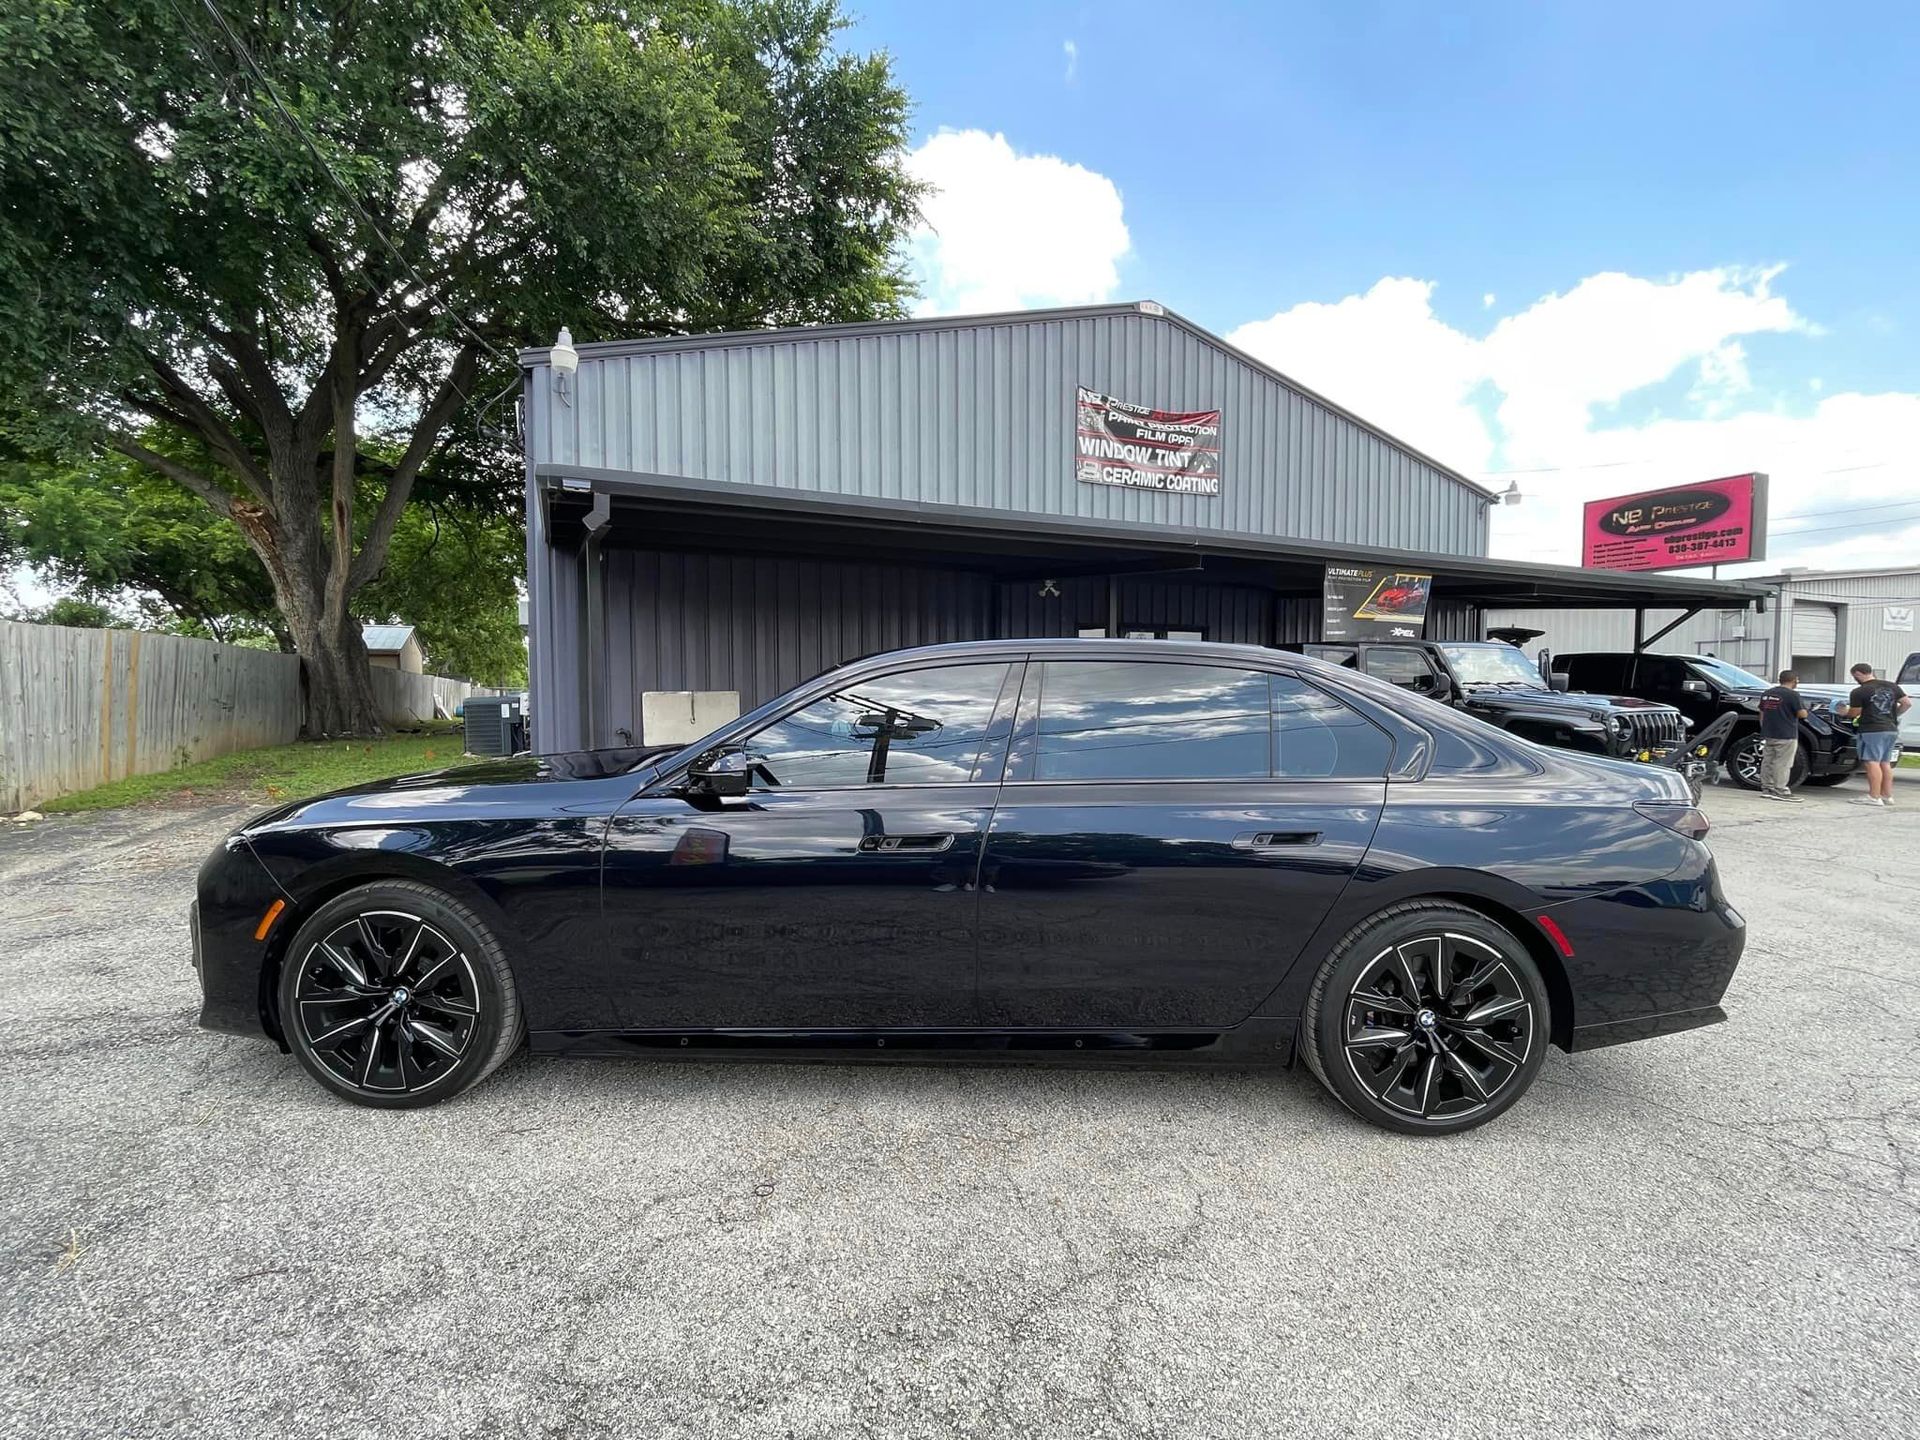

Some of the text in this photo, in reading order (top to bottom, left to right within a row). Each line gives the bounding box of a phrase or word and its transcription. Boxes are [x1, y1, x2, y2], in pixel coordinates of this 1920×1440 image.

[1136, 428, 1194, 447] FILM (PPF)
[1078, 436, 1192, 468] WINDOW TINT
[1103, 467, 1164, 488] CERAMIC
[1166, 475, 1218, 493] COATING
[1390, 627, 1415, 637] XPEL
